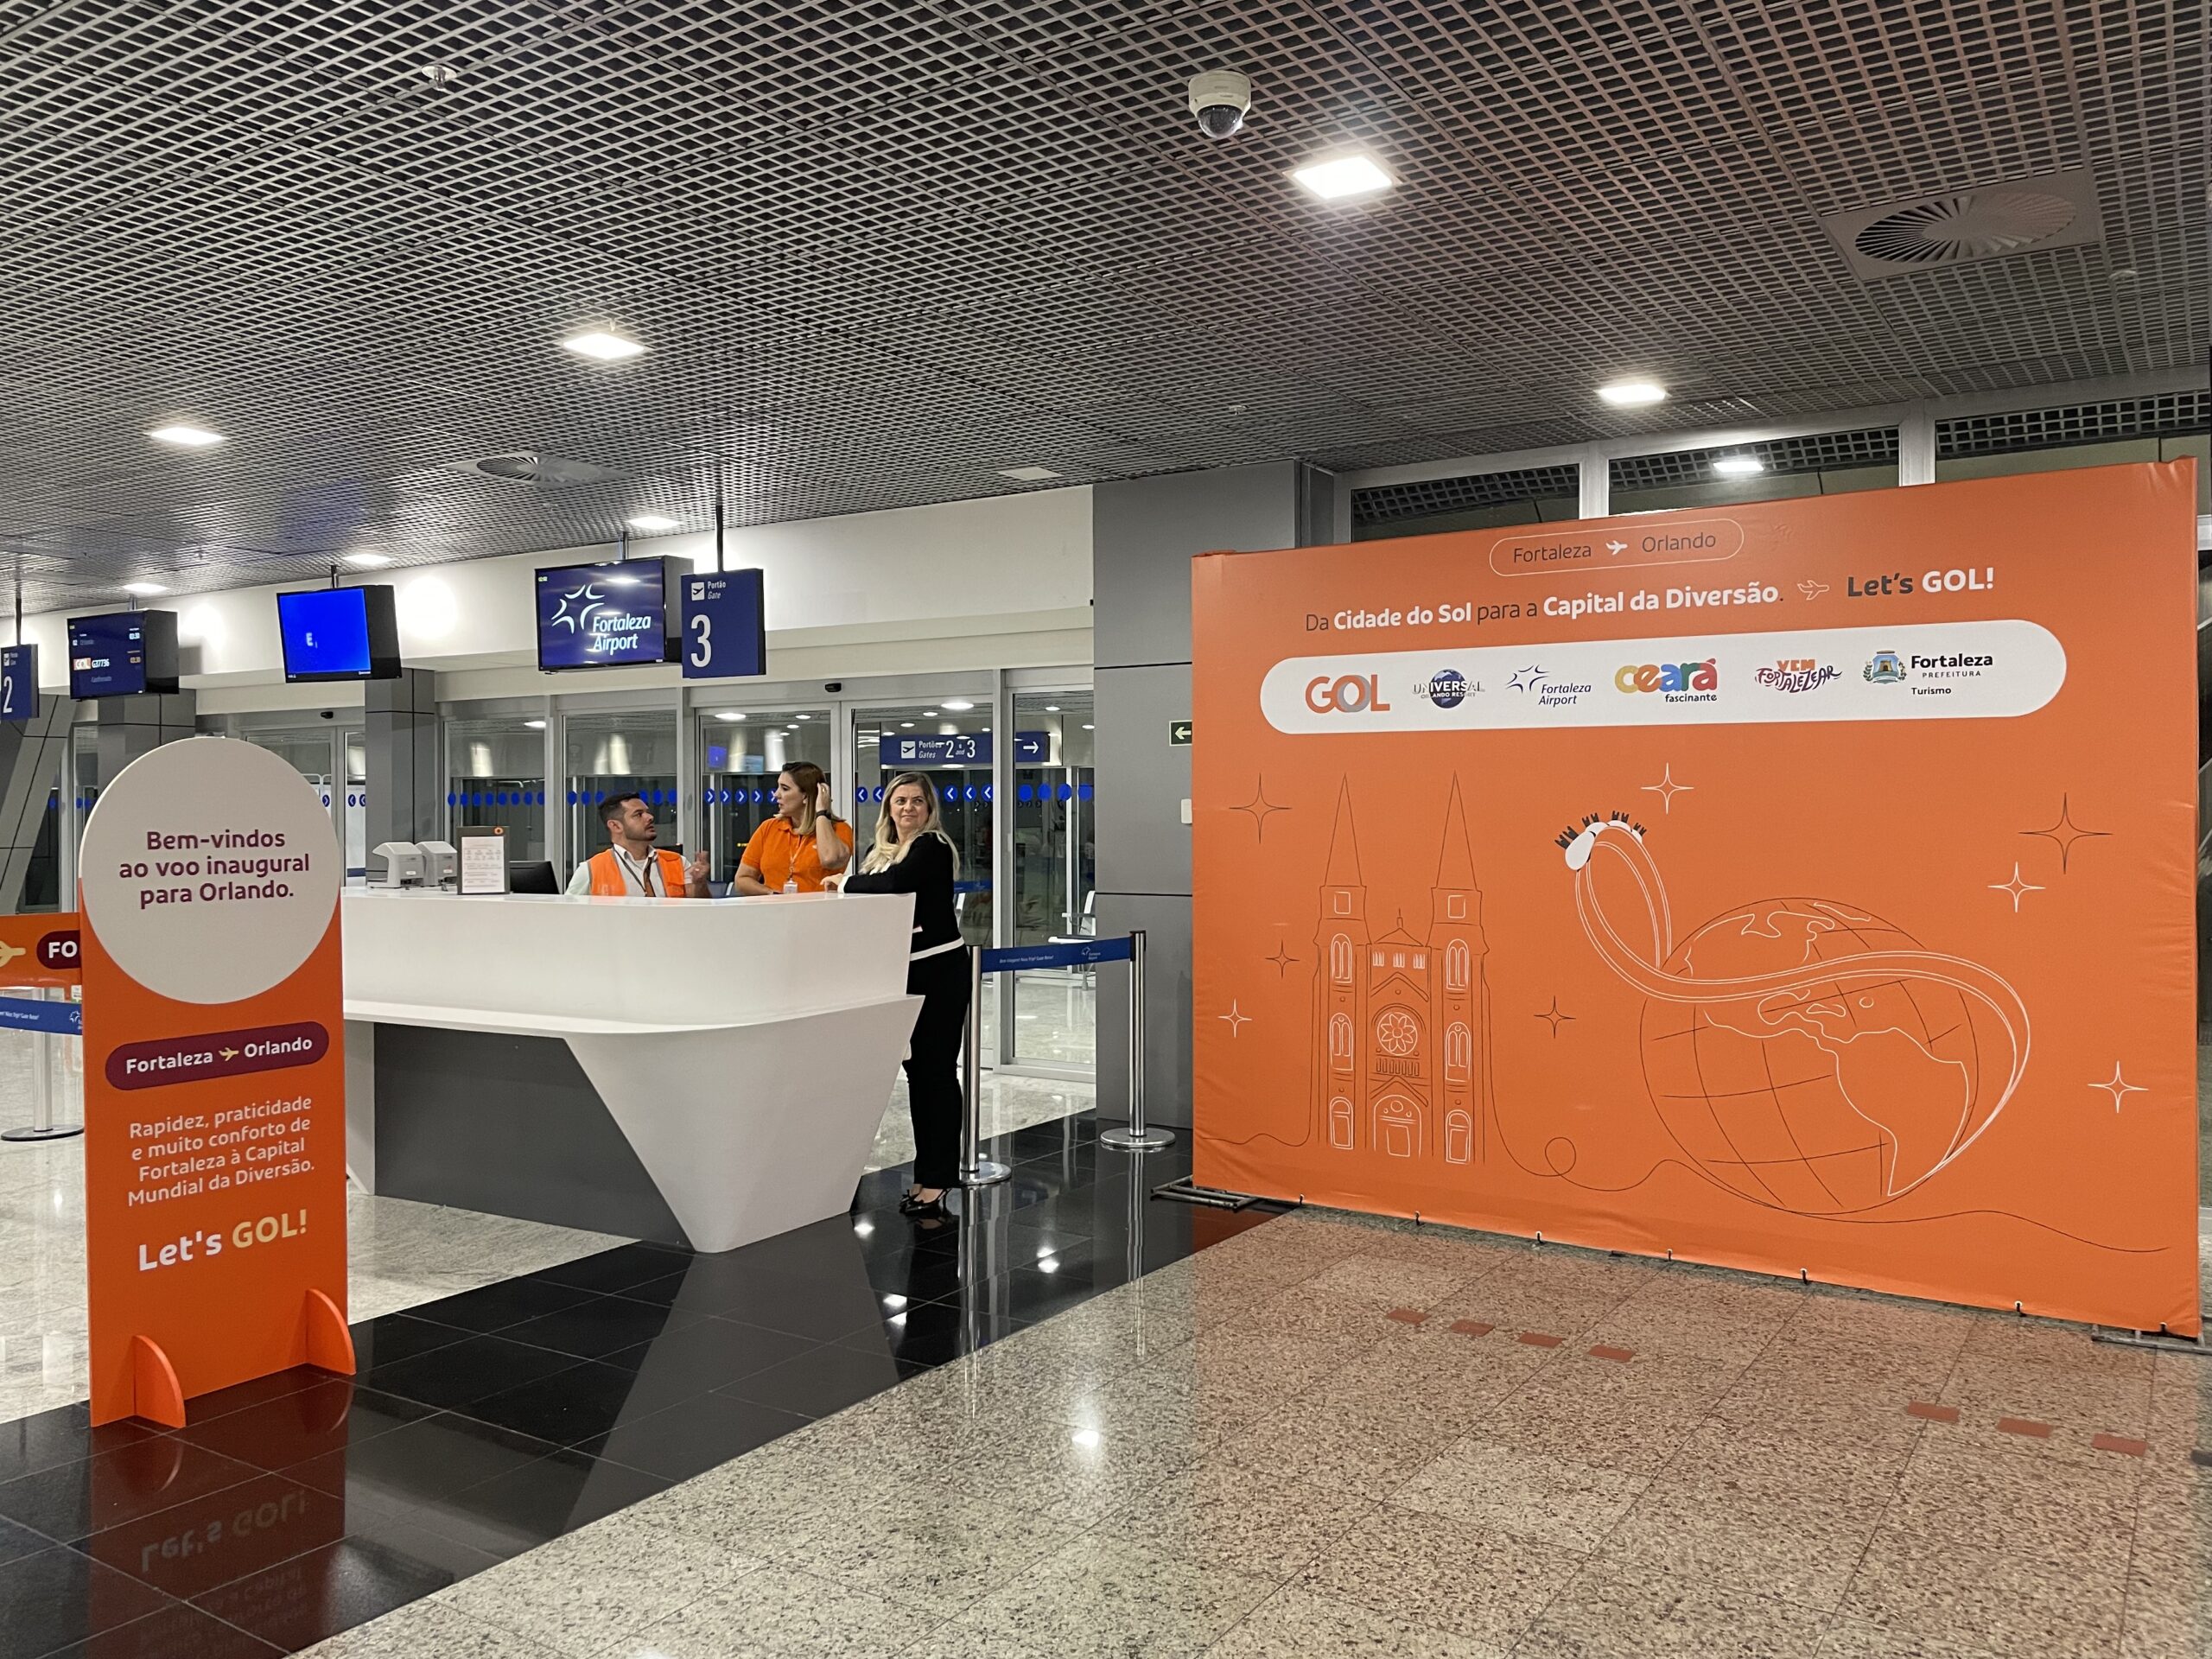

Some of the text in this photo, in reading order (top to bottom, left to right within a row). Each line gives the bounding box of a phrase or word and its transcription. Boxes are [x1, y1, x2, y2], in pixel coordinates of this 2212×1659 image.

[1513, 531, 1717, 563] Fortaleza Orlando
[1847, 567, 1995, 598] Let's GOL!
[1306, 581, 1784, 632] Da Cidade do Sol para a Capital da Diversão.
[592, 613, 652, 632] Fortaleza
[593, 633, 639, 656] Airport
[690, 614, 712, 668] 3
[1910, 652, 1993, 669] Fortaleza
[1412, 680, 1485, 695] UNIVERSAL
[1541, 683, 1592, 694] Fortaleza
[1614, 658, 1719, 694] ceará
[1910, 686, 1952, 696] Turismo
[3, 676, 13, 714] 2
[1305, 673, 1391, 715] GOL
[1538, 695, 1578, 708] Airport
[1664, 692, 1719, 703] fascinante
[945, 740, 955, 759] 2
[966, 740, 976, 759] 3
[146, 829, 286, 852] Bem-vindos
[118, 853, 310, 879] ao voo inaugural
[139, 880, 294, 909] para Orlando.
[125, 1037, 313, 1075] Fortaleza Orlando
[130, 1096, 312, 1140] Rapidez, praticidade
[131, 1116, 311, 1160] e muito conforto de
[138, 1137, 305, 1182] Fortaleza à Capital
[128, 1158, 315, 1207] Mundial da Diversão.
[138, 1209, 308, 1271] Let's GOL!
